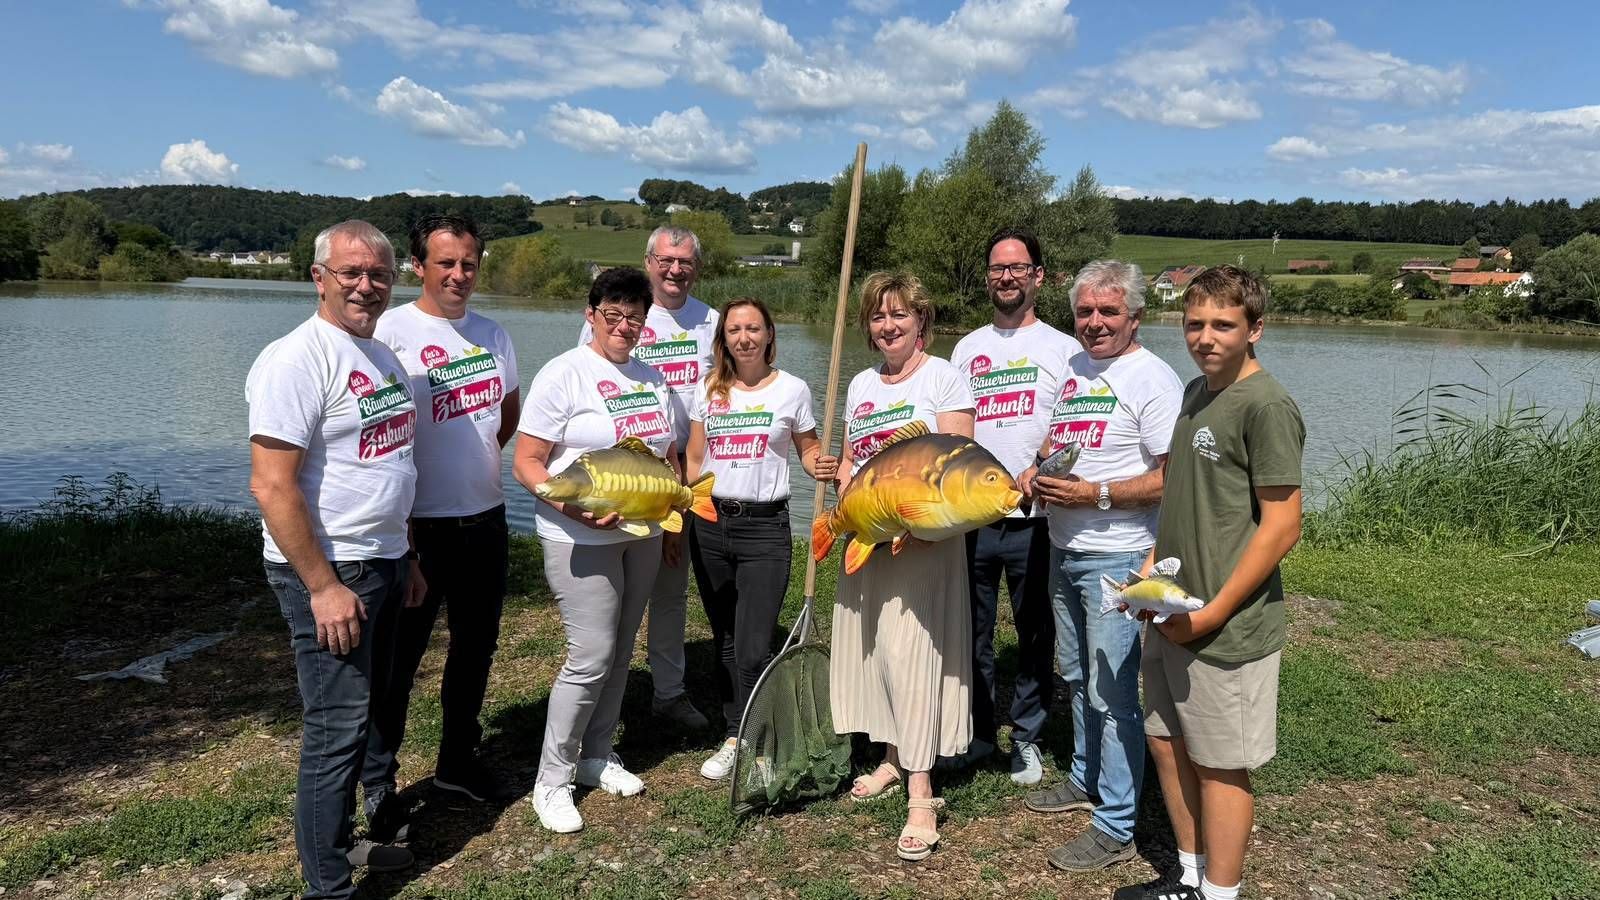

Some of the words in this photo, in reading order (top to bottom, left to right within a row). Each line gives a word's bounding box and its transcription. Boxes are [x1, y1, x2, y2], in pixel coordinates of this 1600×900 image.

[424, 349, 440, 360] let's
[427, 353, 448, 368] grow!
[635, 344, 697, 359] Bäuerinnen
[350, 375, 365, 387] let's
[429, 358, 495, 384] Bäuerinnen
[970, 372, 1036, 390] Bäuerinnen
[434, 380, 501, 424] Zukunft
[606, 396, 658, 411] Bäuerinnen
[975, 393, 1032, 418] ukunft
[1054, 400, 1113, 416] Bäuerinnen
[616, 412, 669, 442] Zukunft
[707, 415, 770, 429] Bäuerinnen
[851, 409, 912, 432] Bäuerinnen
[361, 412, 416, 463] Zukunft
[1049, 422, 1101, 449] Zukunft
[710, 436, 764, 460] Zukunft
